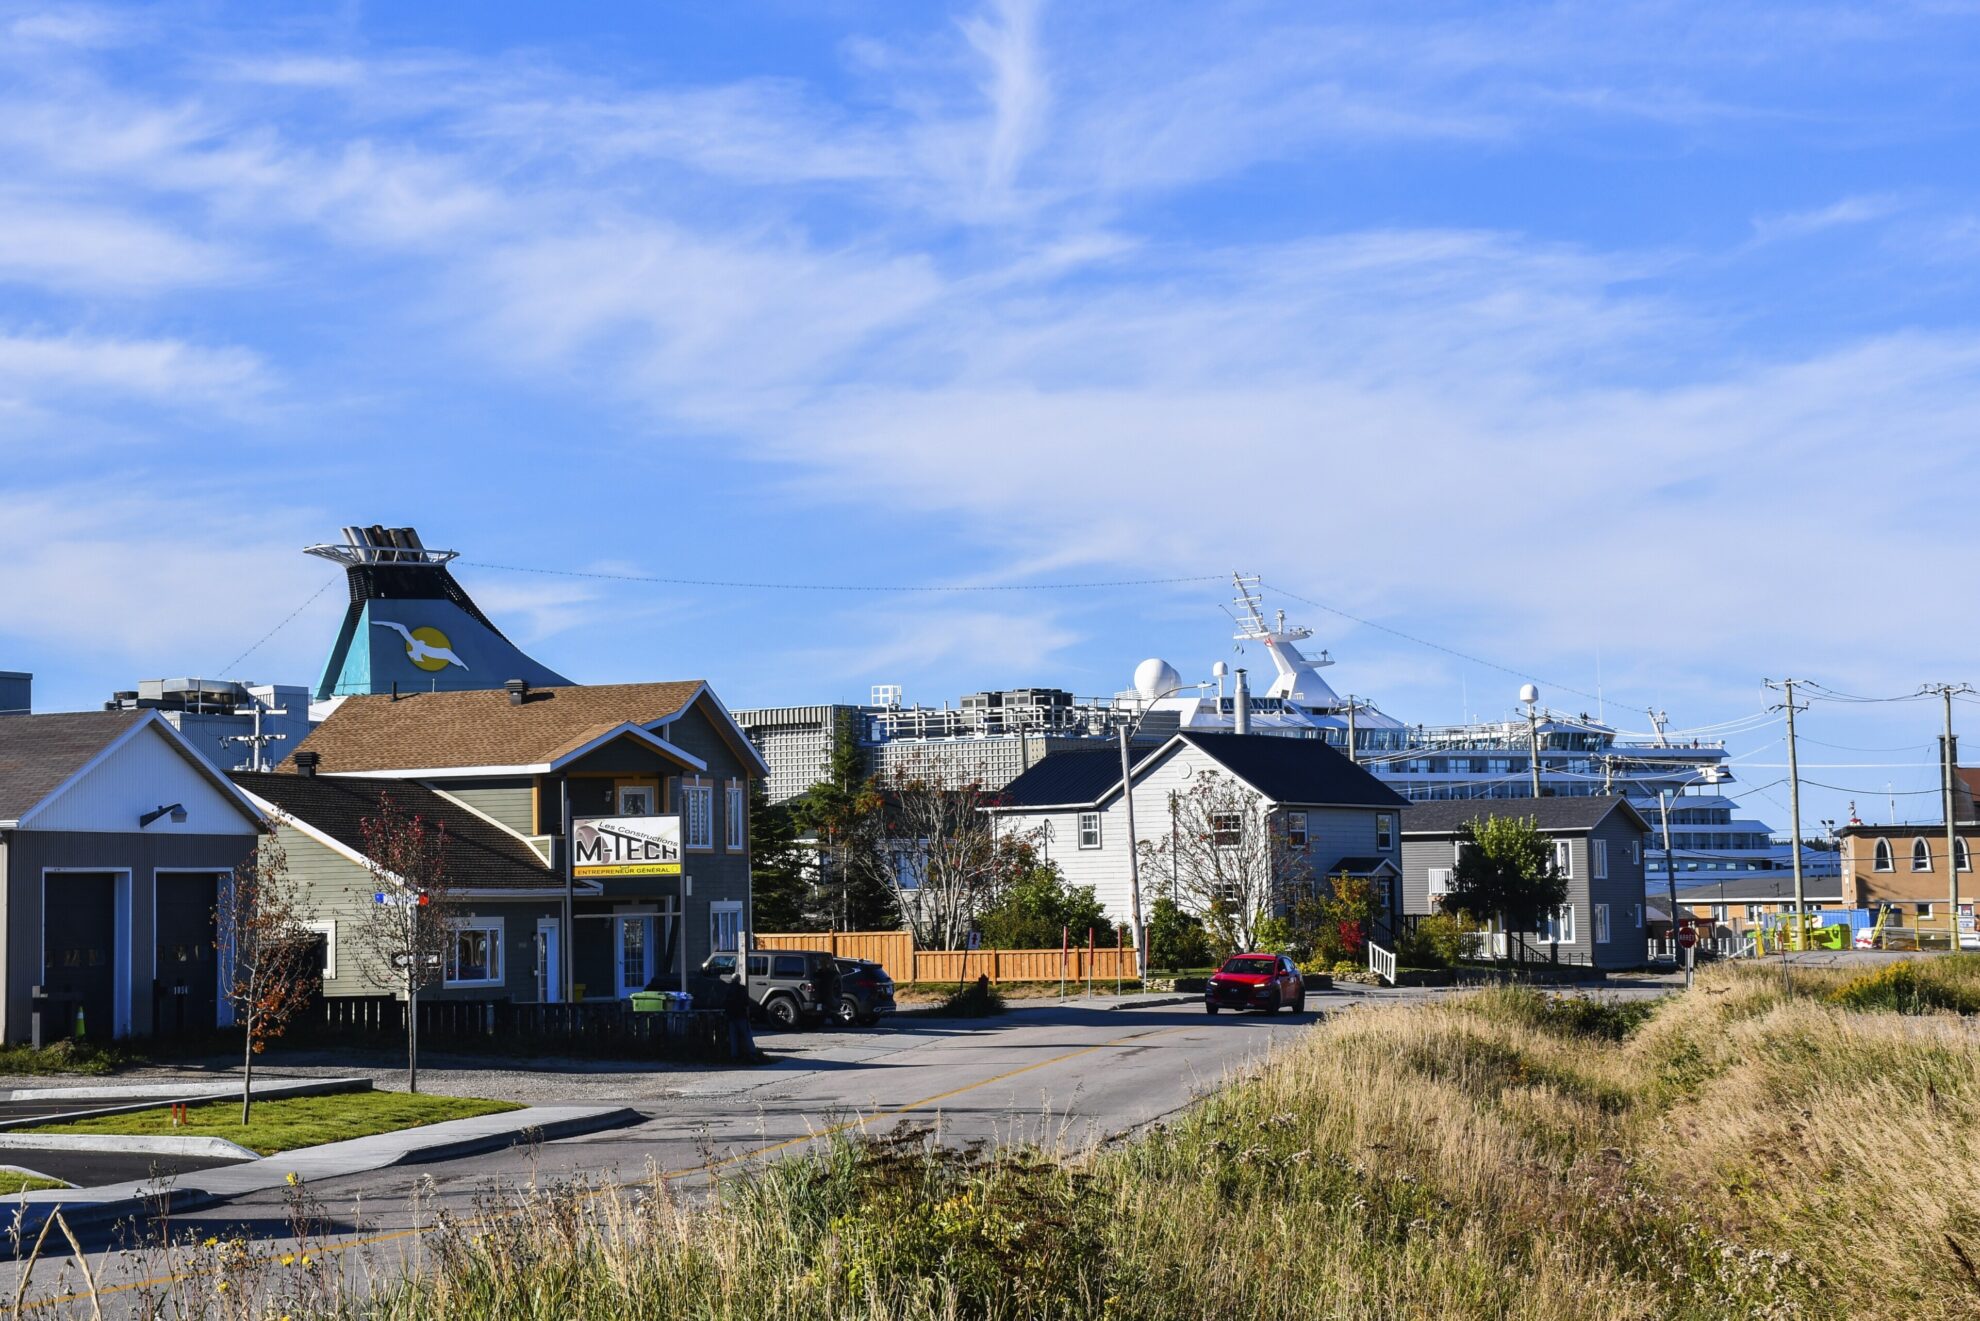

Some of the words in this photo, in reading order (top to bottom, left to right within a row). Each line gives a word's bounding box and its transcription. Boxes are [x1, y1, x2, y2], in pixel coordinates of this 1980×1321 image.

[1222, 698, 1280, 710] AANIA
[599, 821, 615, 831] Les
[617, 826, 679, 848] Constructions
[576, 827, 678, 862] M-TECH
[577, 867, 635, 875] ENTREPRENEUR
[636, 866, 671, 874] GÉNÉRAL
